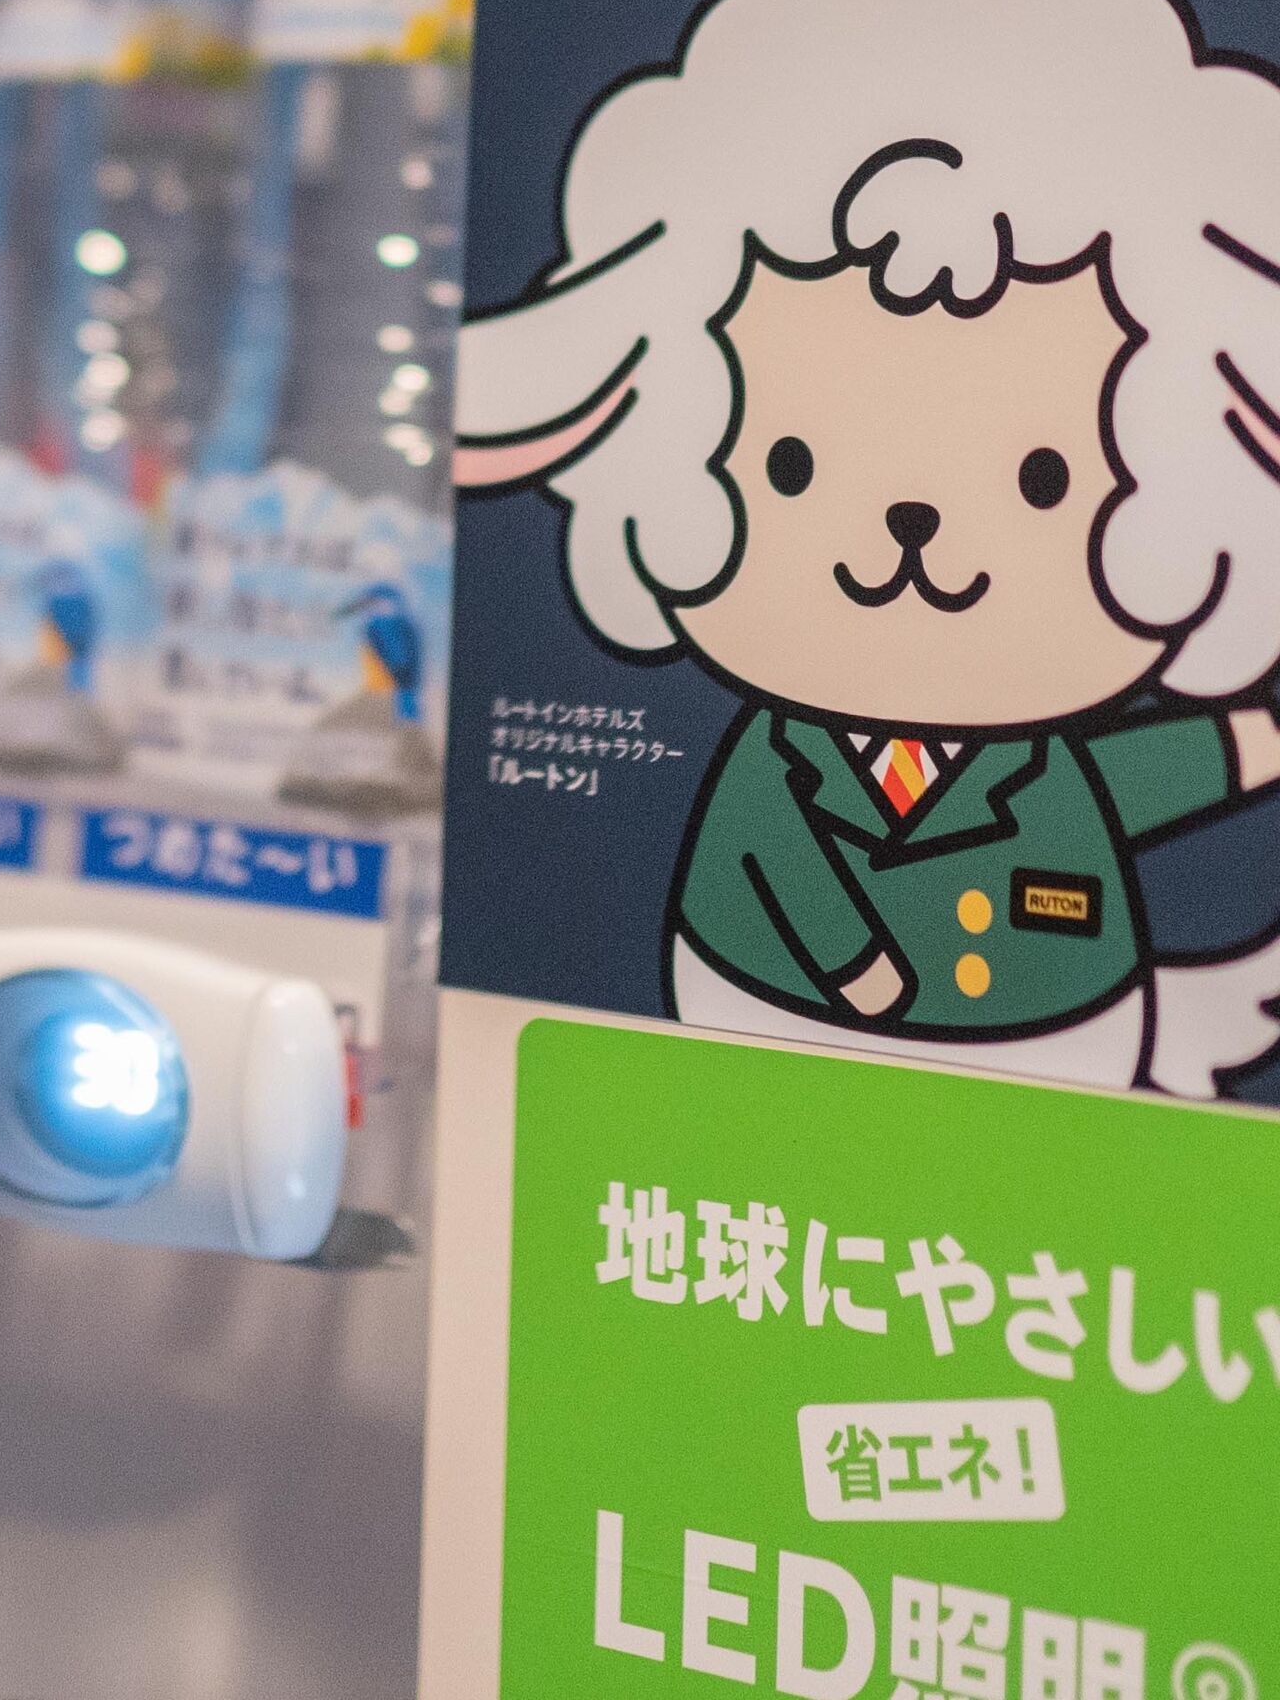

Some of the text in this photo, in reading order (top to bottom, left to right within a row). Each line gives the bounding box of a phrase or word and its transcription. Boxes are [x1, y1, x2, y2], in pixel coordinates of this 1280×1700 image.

[492, 697, 646, 731] ルートインホテルズ
[1029, 892, 1084, 913] RUTON
[594, 1180, 1280, 1404] 地球にやさしい
